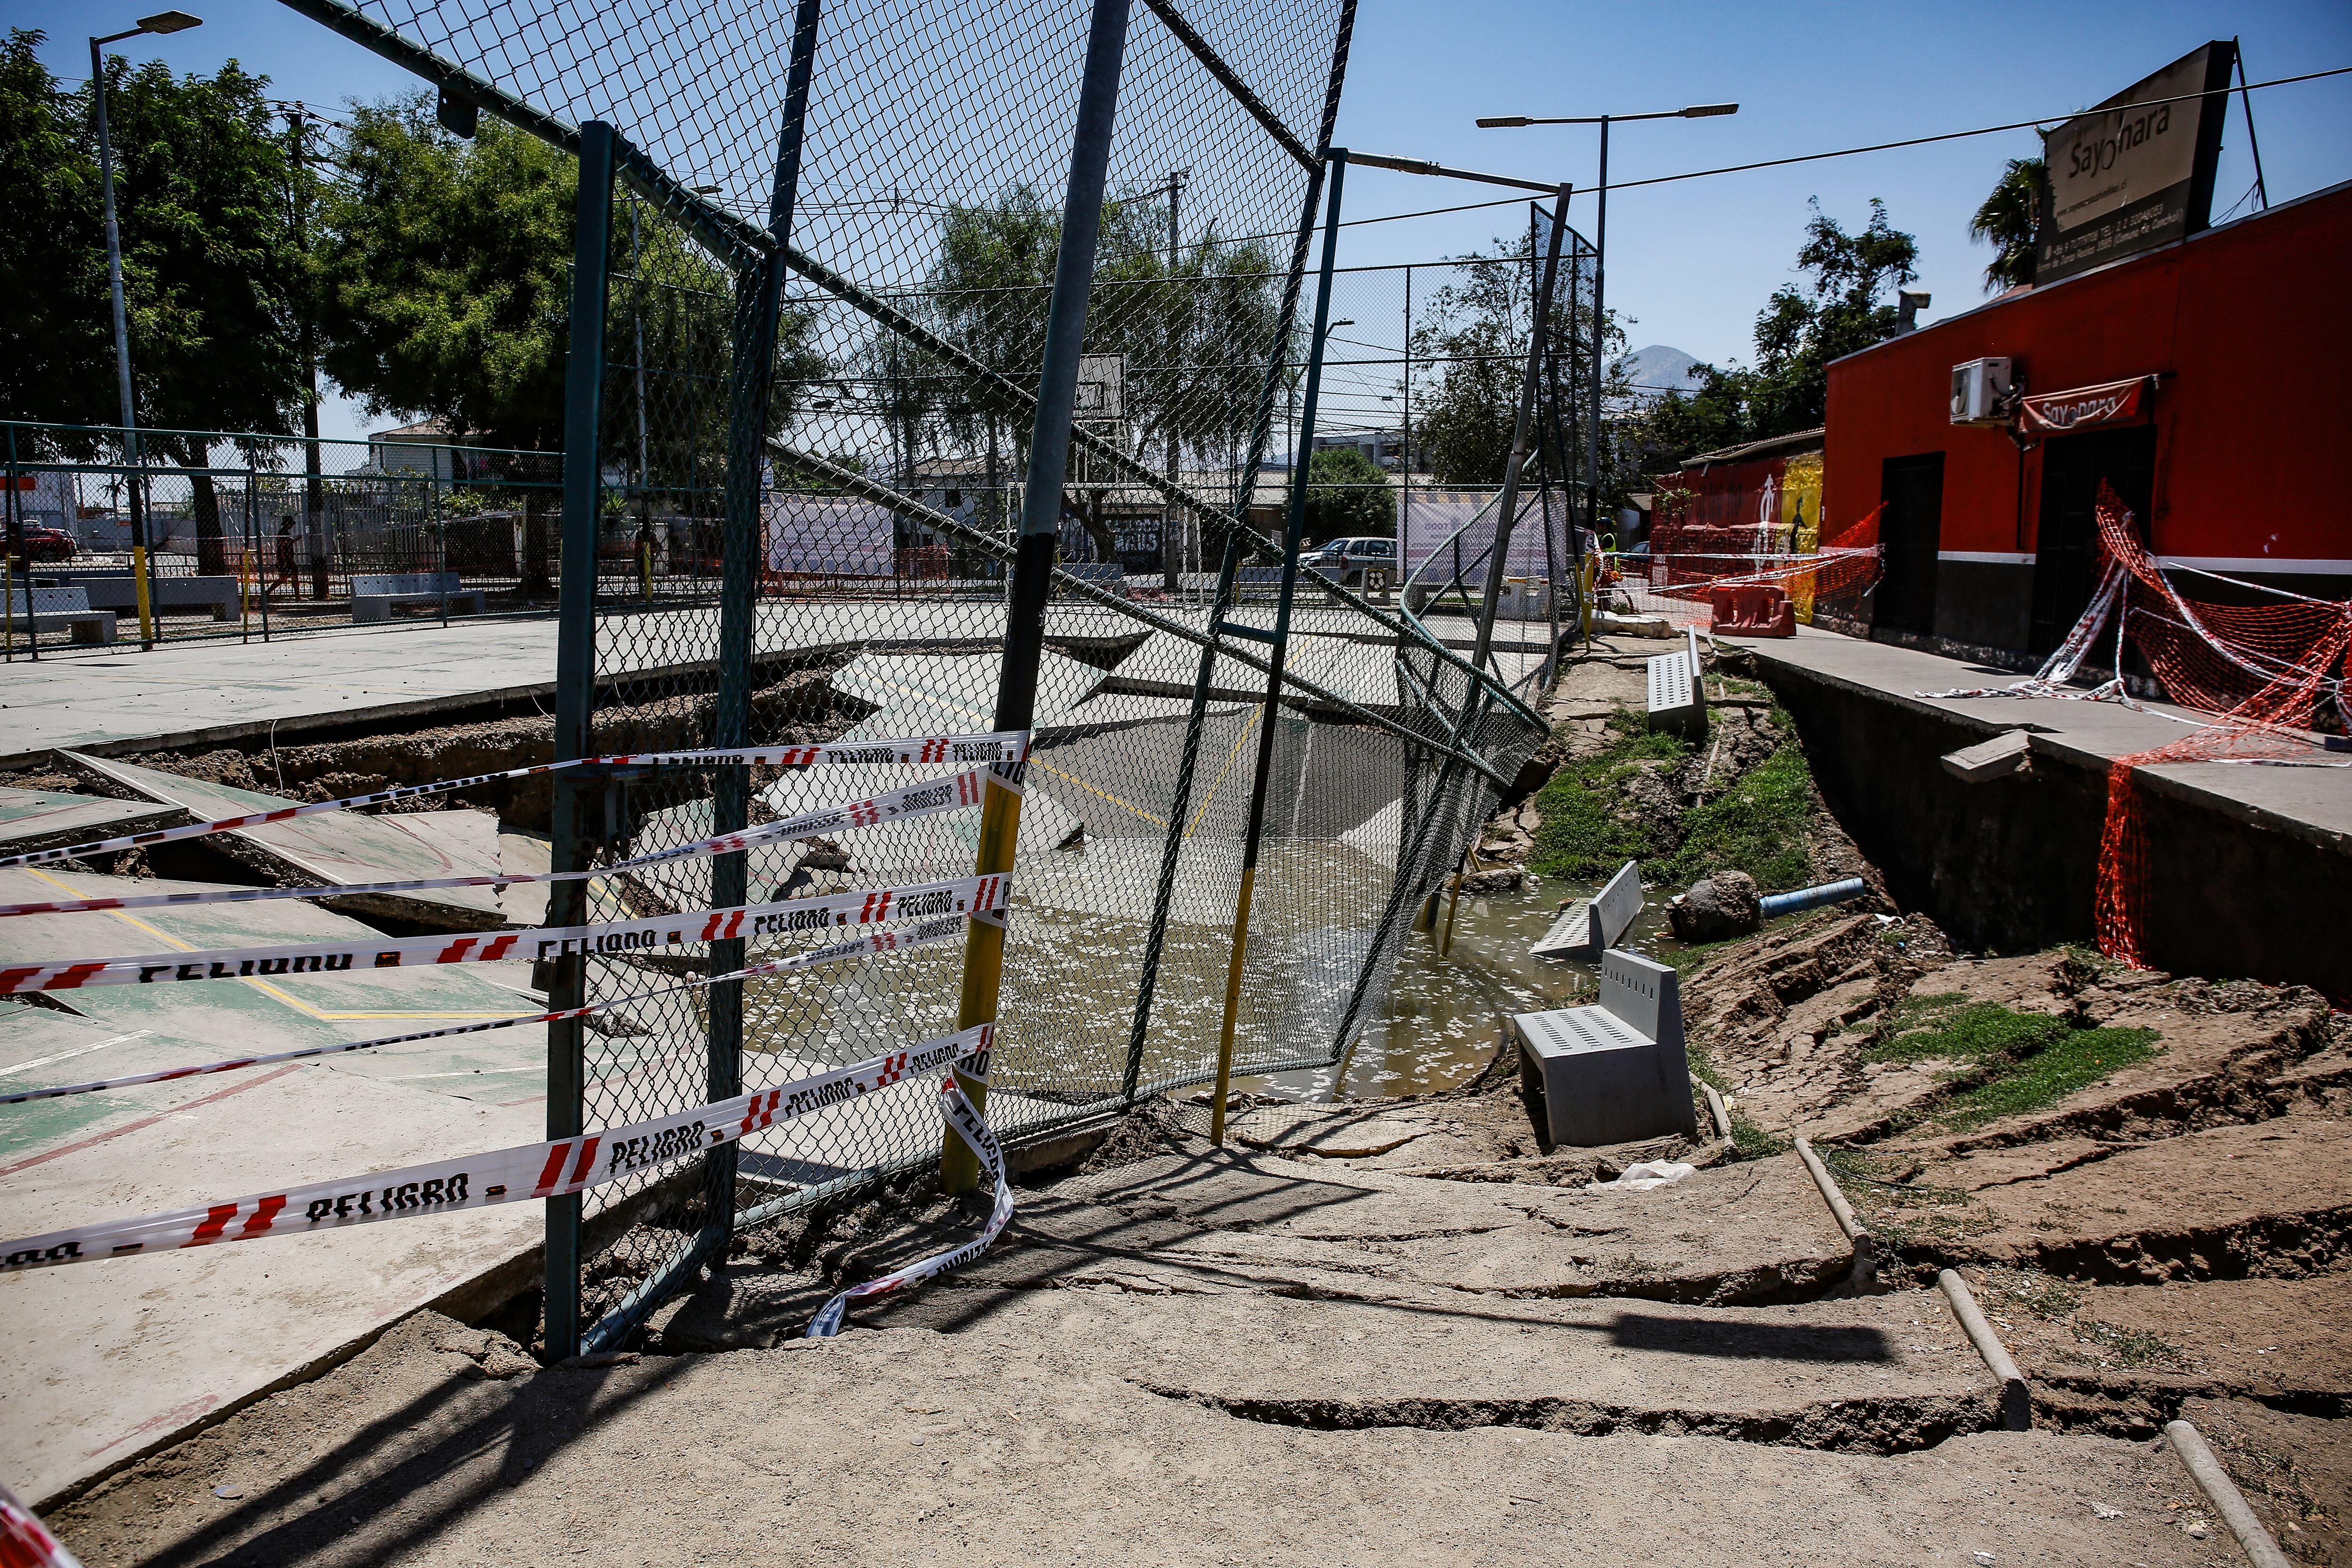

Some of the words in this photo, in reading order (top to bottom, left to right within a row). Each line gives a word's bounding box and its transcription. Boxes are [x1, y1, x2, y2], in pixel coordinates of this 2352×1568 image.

[2068, 104, 2170, 178] Sayonara
[754, 907, 830, 936] PELIGRO
[896, 890, 954, 918] PELIGRO
[609, 1120, 706, 1177] PELIGRO
[785, 1076, 854, 1119] PELIGRO
[909, 1043, 960, 1075] PELIGRO
